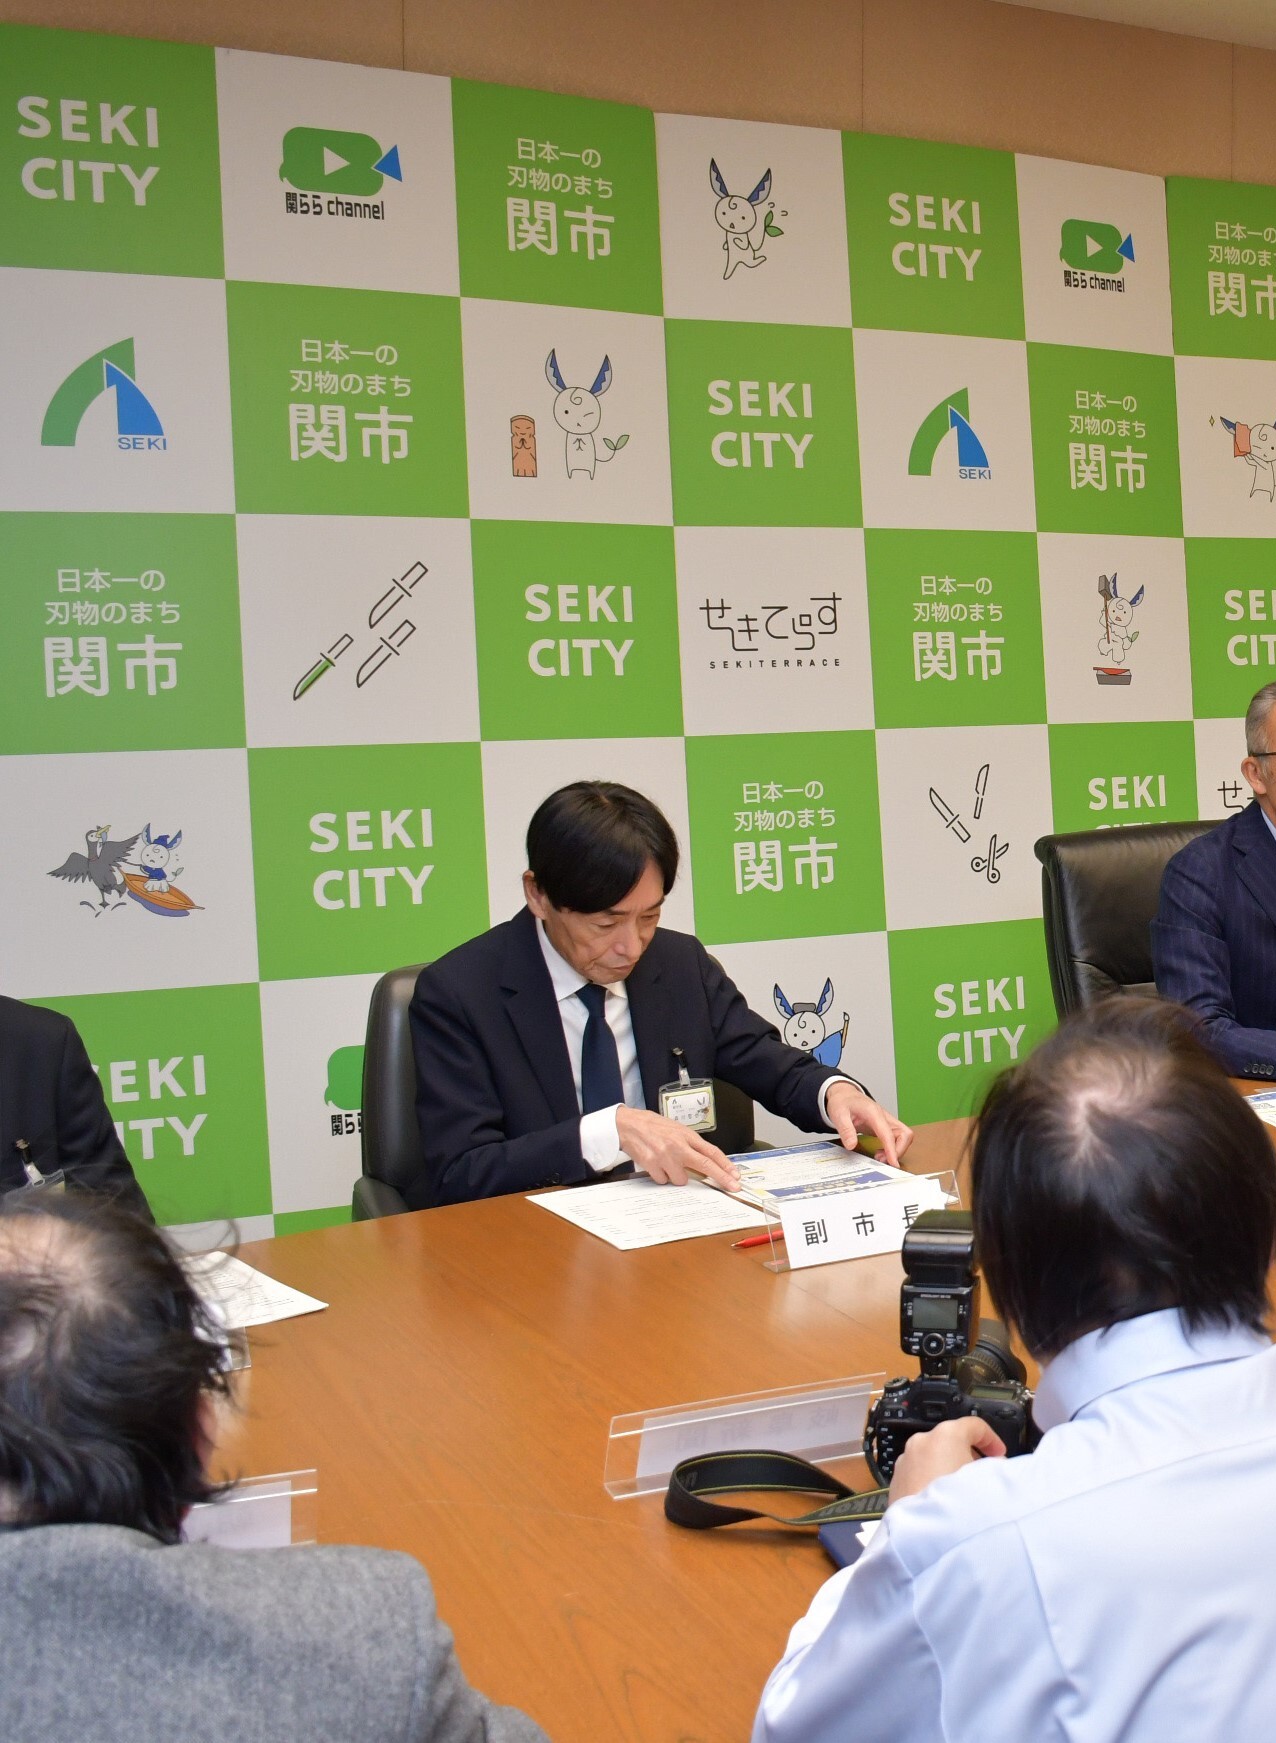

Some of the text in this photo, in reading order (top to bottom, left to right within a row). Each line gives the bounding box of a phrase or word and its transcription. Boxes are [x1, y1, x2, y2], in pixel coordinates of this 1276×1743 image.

[17, 96, 158, 147] SEKI
[517, 138, 601, 168] 日本一の
[21, 157, 159, 206] CITY
[507, 166, 613, 198] 刃物のまち
[285, 192, 384, 220] 関らら channel
[889, 193, 981, 234] SEKI
[507, 197, 615, 260] 関市
[892, 242, 981, 281] CITY
[1064, 270, 1124, 292] 関らら channel
[301, 339, 398, 365] 日本一の
[290, 369, 411, 397] 刃物のまち
[708, 380, 812, 418] SEKI
[1076, 390, 1137, 412] 日本一の
[118, 437, 167, 450] SEKI
[289, 403, 413, 464] 関市
[1069, 415, 1145, 438] 刃物のまち
[711, 432, 813, 468] CITY
[1069, 443, 1147, 493] 関市
[959, 469, 991, 479] SEKI
[57, 568, 165, 592] 日本一の
[921, 576, 992, 595] 日本一の
[46, 601, 180, 625] 刃物のまち
[525, 584, 633, 622] SEKI
[913, 602, 1003, 622] 刃物のまち
[700, 592, 842, 651] せきてらす
[44, 634, 182, 697] 関市
[529, 639, 634, 676] CITY
[710, 659, 839, 669] SEKITERRACE
[913, 630, 1005, 681] 関市
[743, 781, 824, 803] 日本一の
[1088, 775, 1166, 810] SEKI
[310, 809, 433, 852] SEKI
[735, 808, 835, 831] 刃物のまち
[734, 836, 838, 894] 関市
[313, 865, 434, 910] CITY
[934, 976, 1025, 1018] SEKI
[938, 1025, 1026, 1067] CITY
[91, 1055, 207, 1103] EKI
